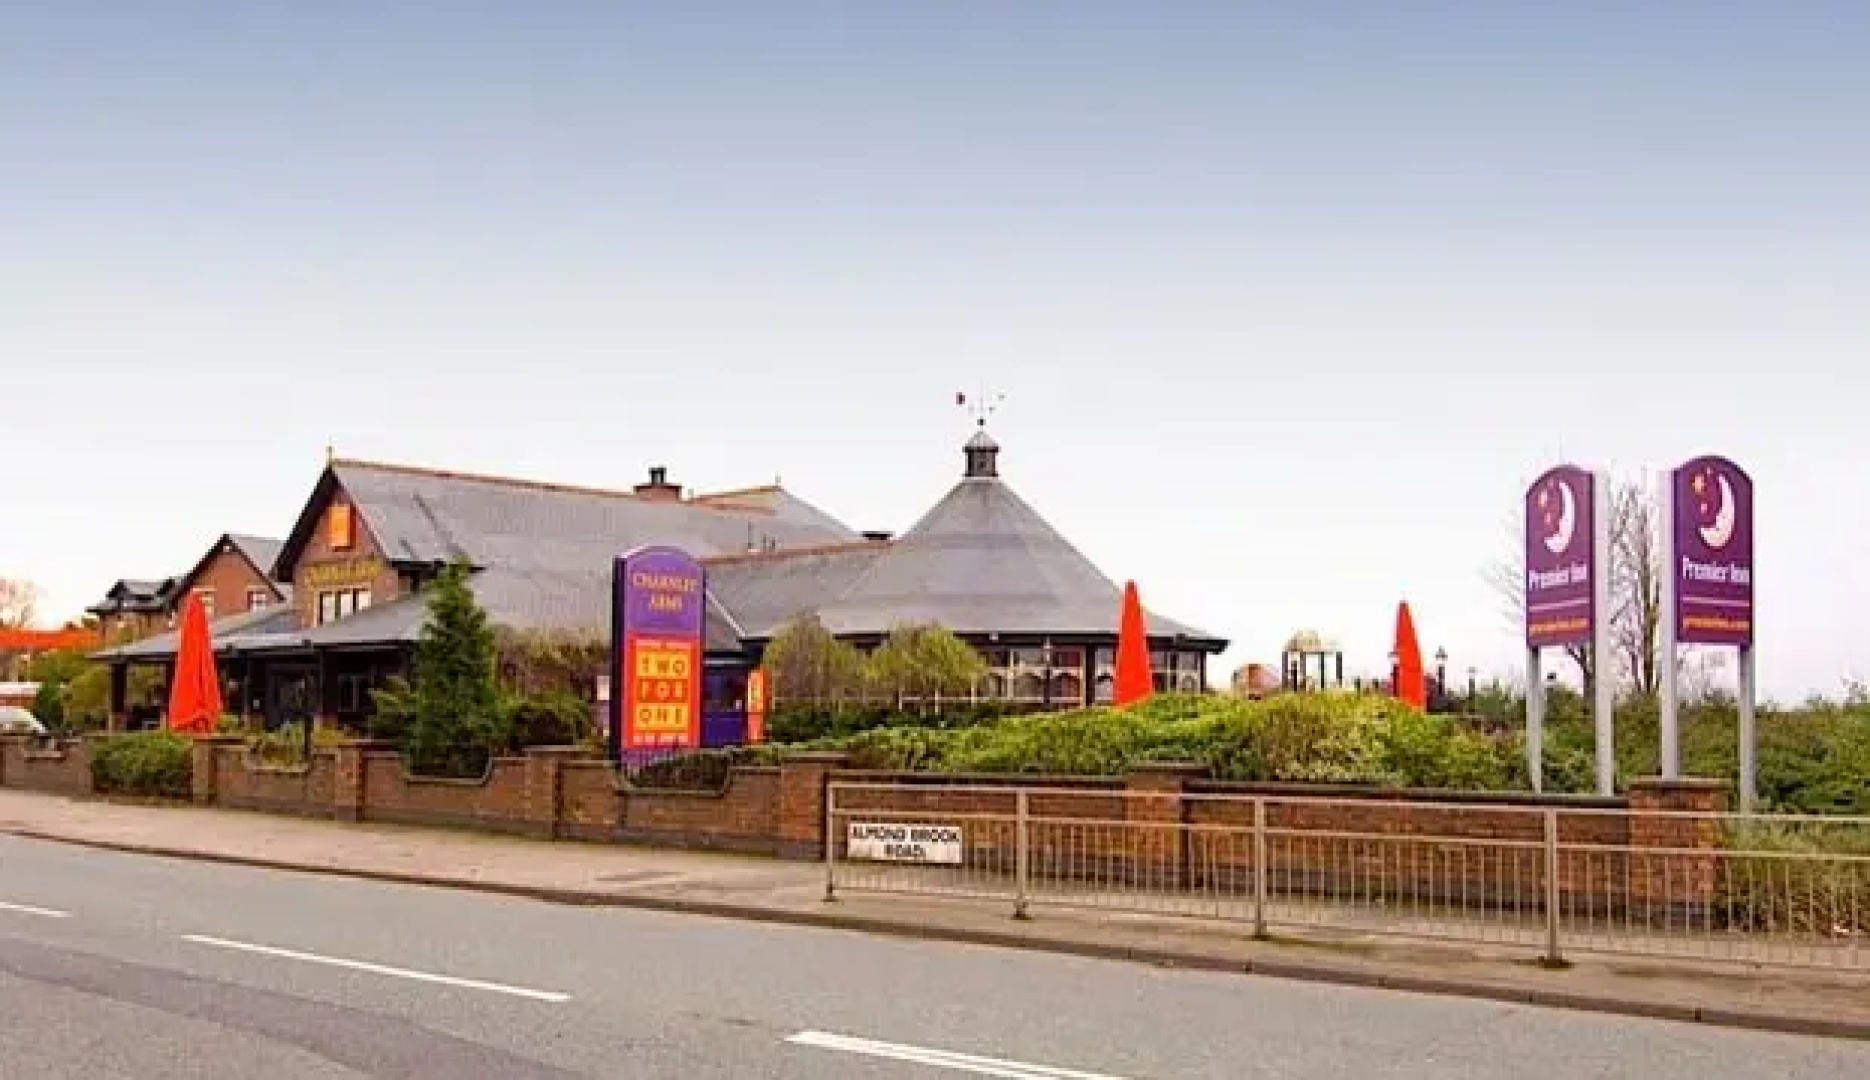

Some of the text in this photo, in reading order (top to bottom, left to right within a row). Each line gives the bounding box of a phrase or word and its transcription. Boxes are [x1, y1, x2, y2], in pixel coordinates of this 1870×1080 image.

[1528, 560, 1588, 590] Premier Inn
[1681, 555, 1750, 585] Premier Inn
[632, 572, 698, 592] CHARNLEY
[649, 594, 683, 612] ARMS
[641, 655, 687, 675] TWO
[640, 681, 685, 699] FOR
[638, 707, 685, 725] ONE
[851, 826, 960, 844] ALMOND BROOK
[884, 844, 926, 858] ROAD
